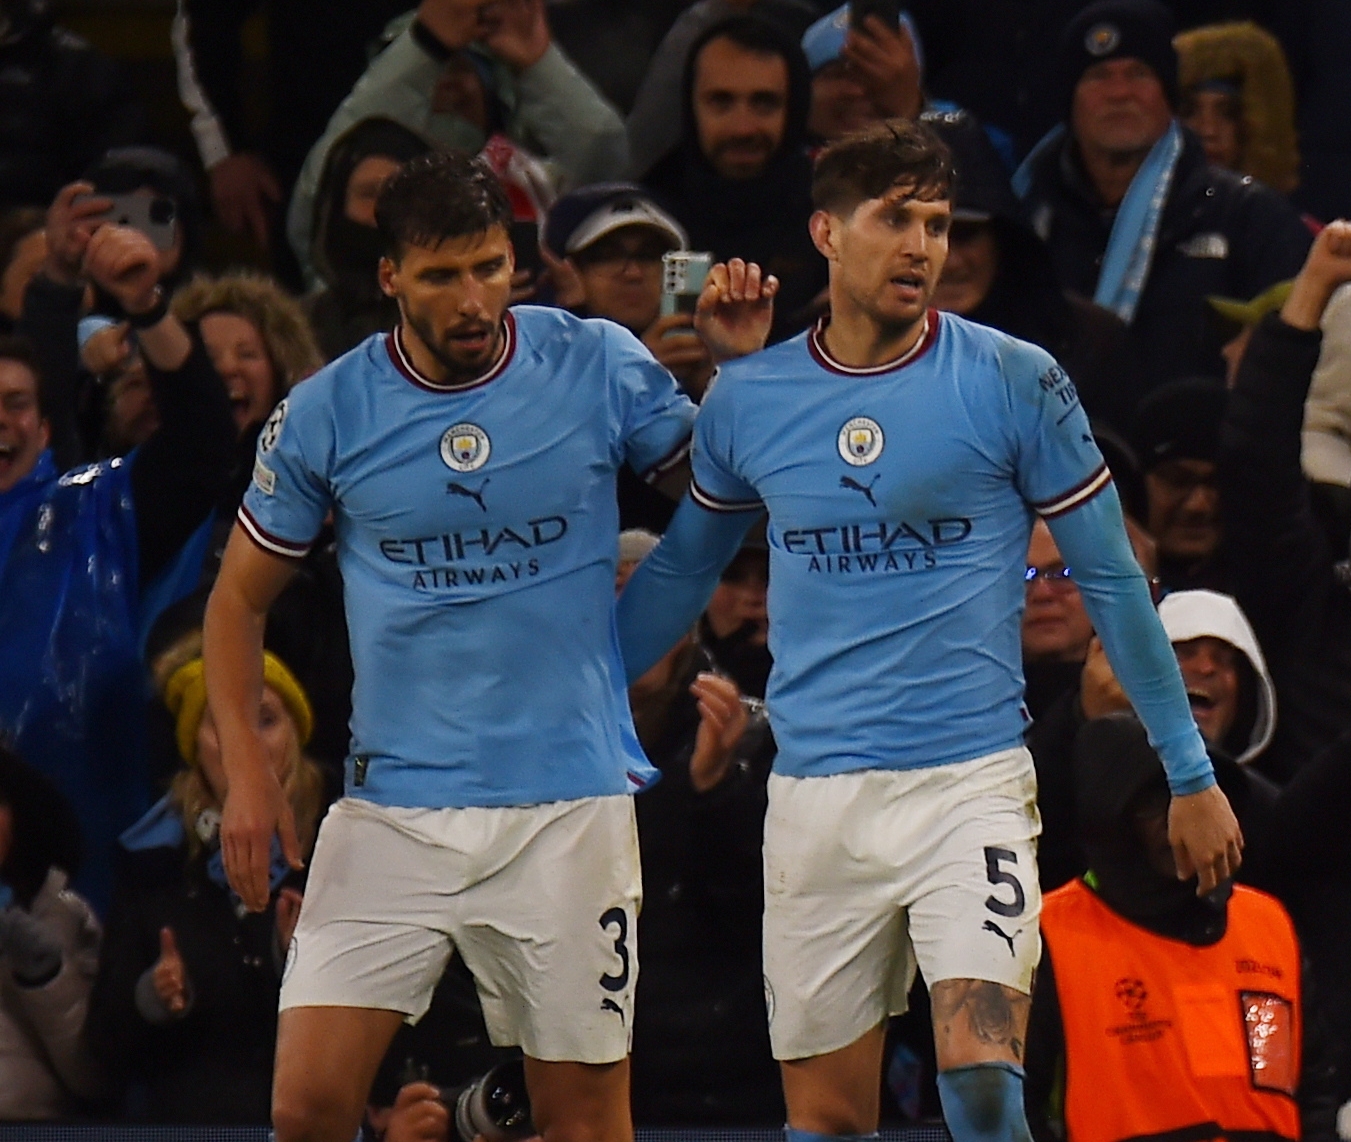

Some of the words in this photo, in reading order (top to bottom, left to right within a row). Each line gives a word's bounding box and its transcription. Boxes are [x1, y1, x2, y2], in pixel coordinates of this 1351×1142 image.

[379, 515, 568, 565] ETIHAD
[783, 517, 972, 555] ETIHAD
[413, 558, 540, 591] AIRWAYS
[808, 549, 937, 574] AIRWAYS
[983, 846, 1024, 918] 5
[599, 906, 629, 992] 3
